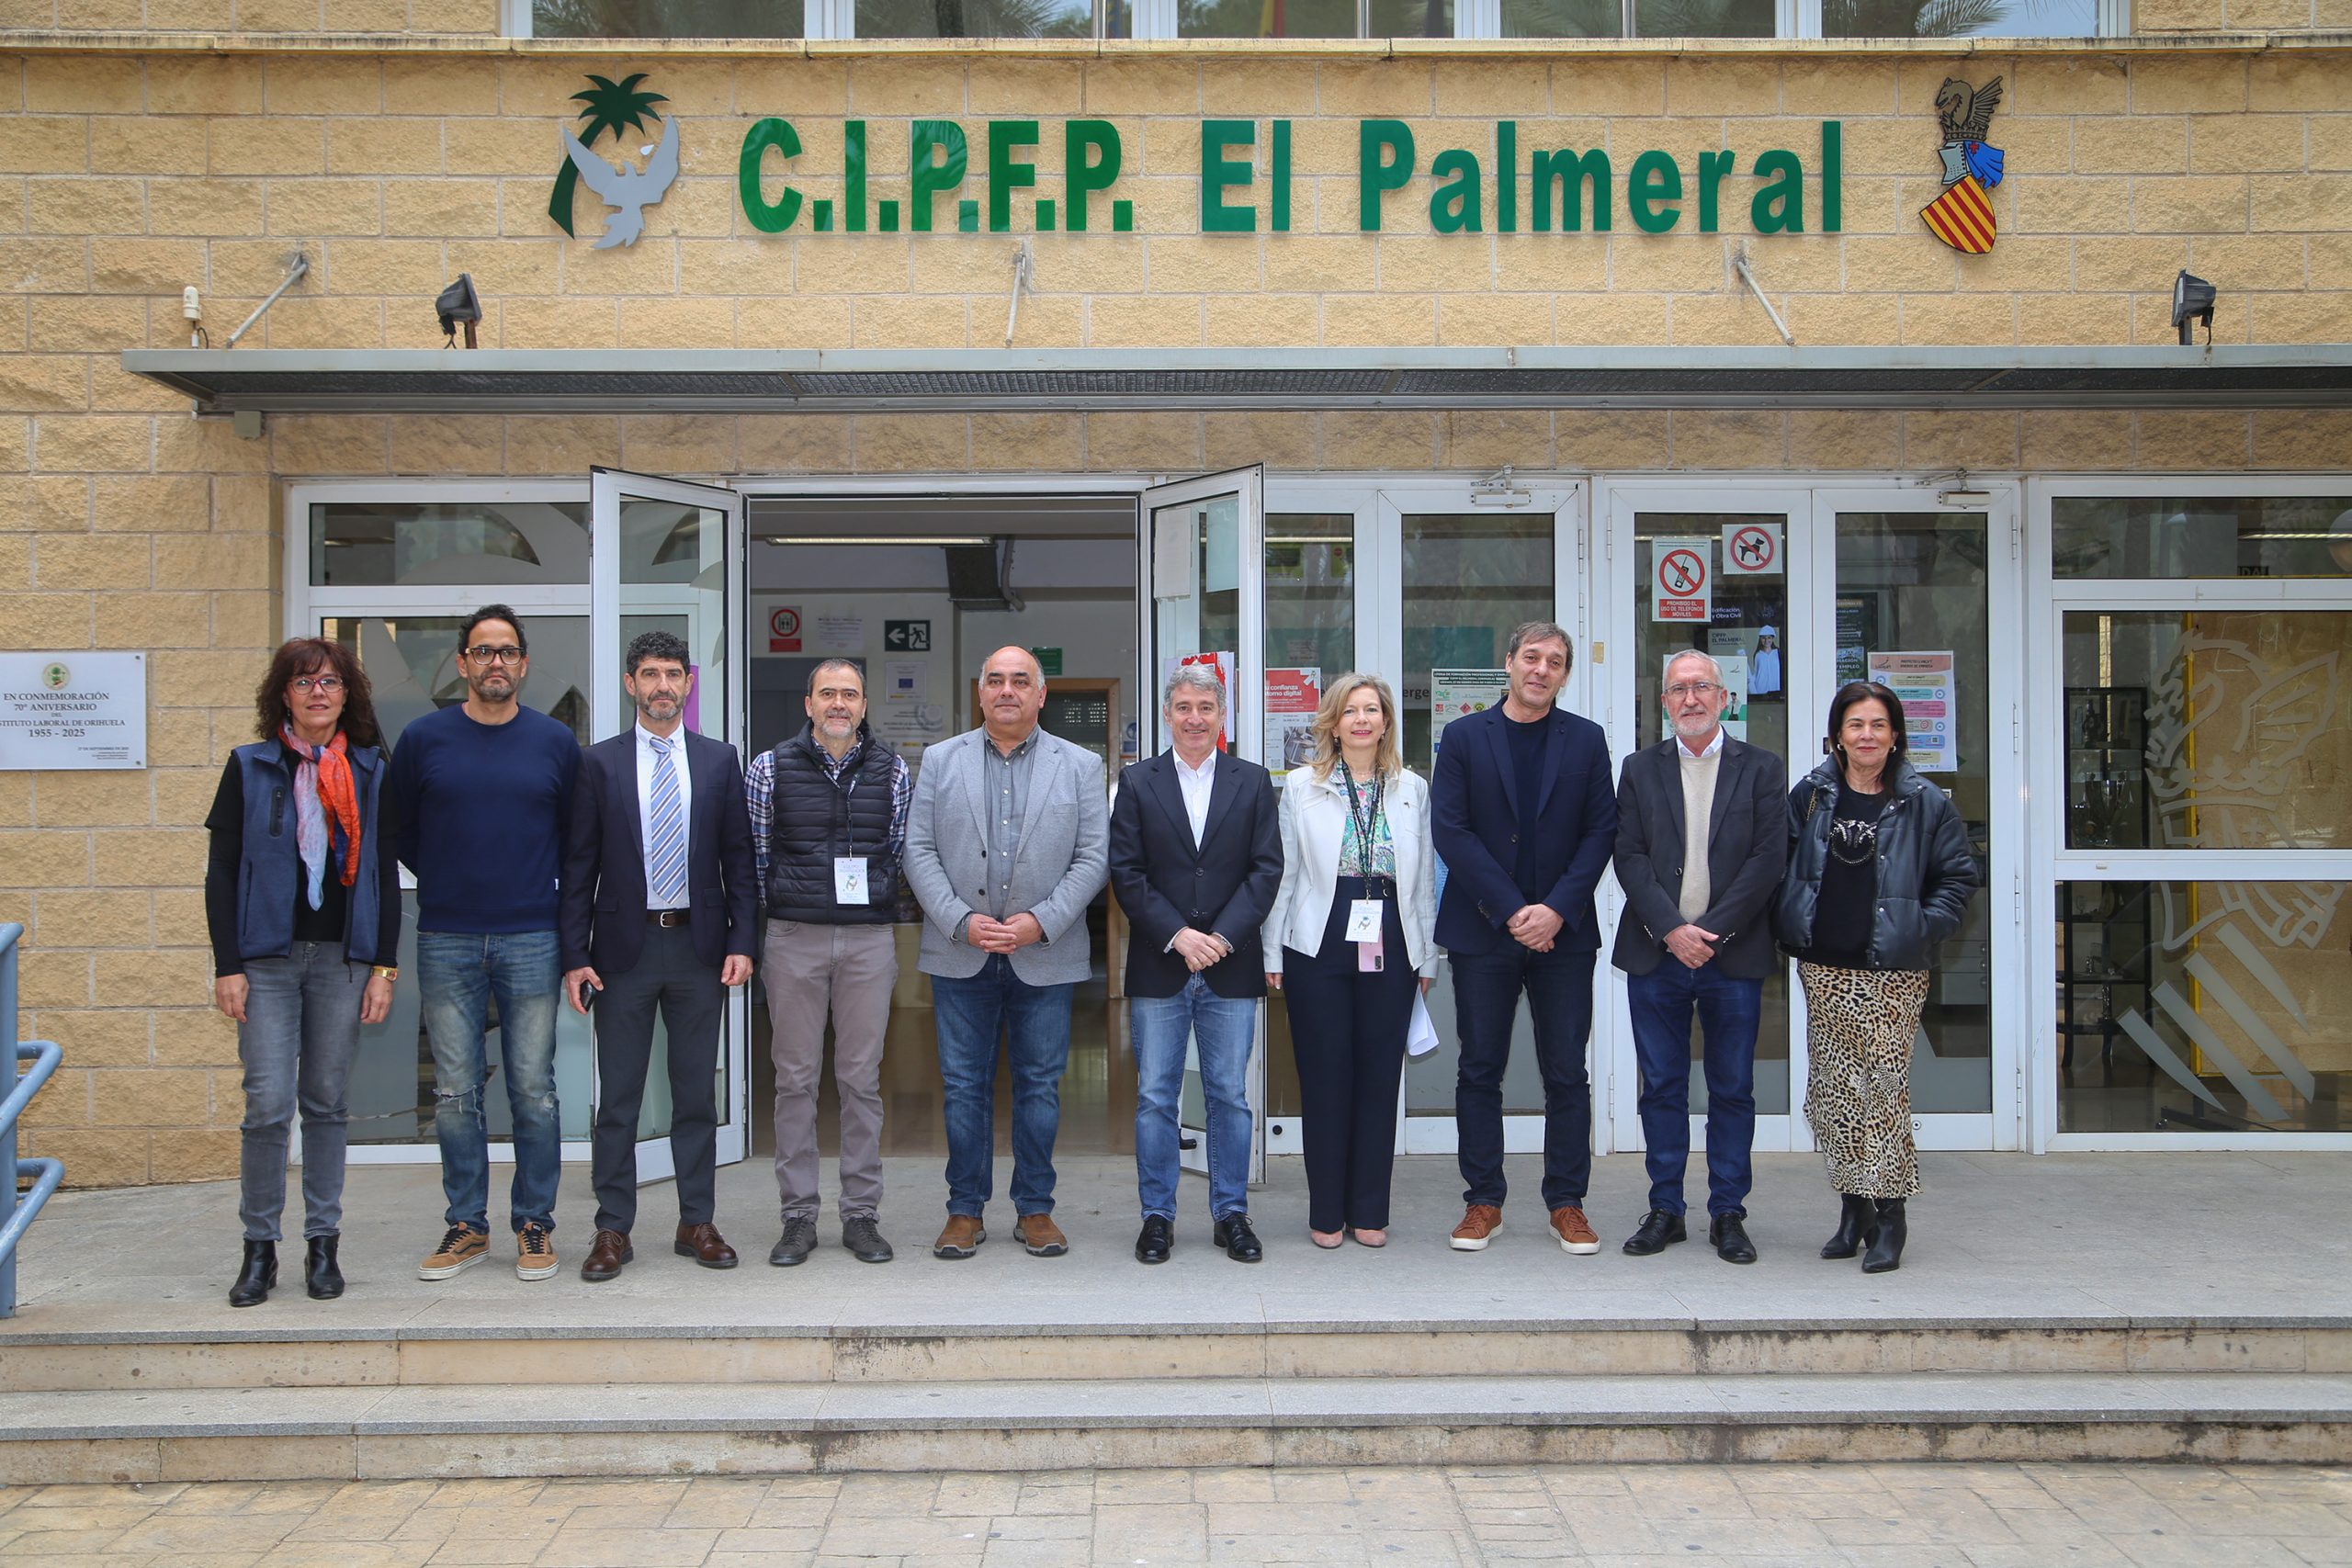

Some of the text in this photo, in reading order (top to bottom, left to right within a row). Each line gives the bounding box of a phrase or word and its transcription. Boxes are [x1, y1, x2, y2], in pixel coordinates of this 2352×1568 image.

[739, 117, 1842, 234] C.I.P.F.P. El Palmeral
[4, 692, 109, 701] EN CONMEMORACIÓN
